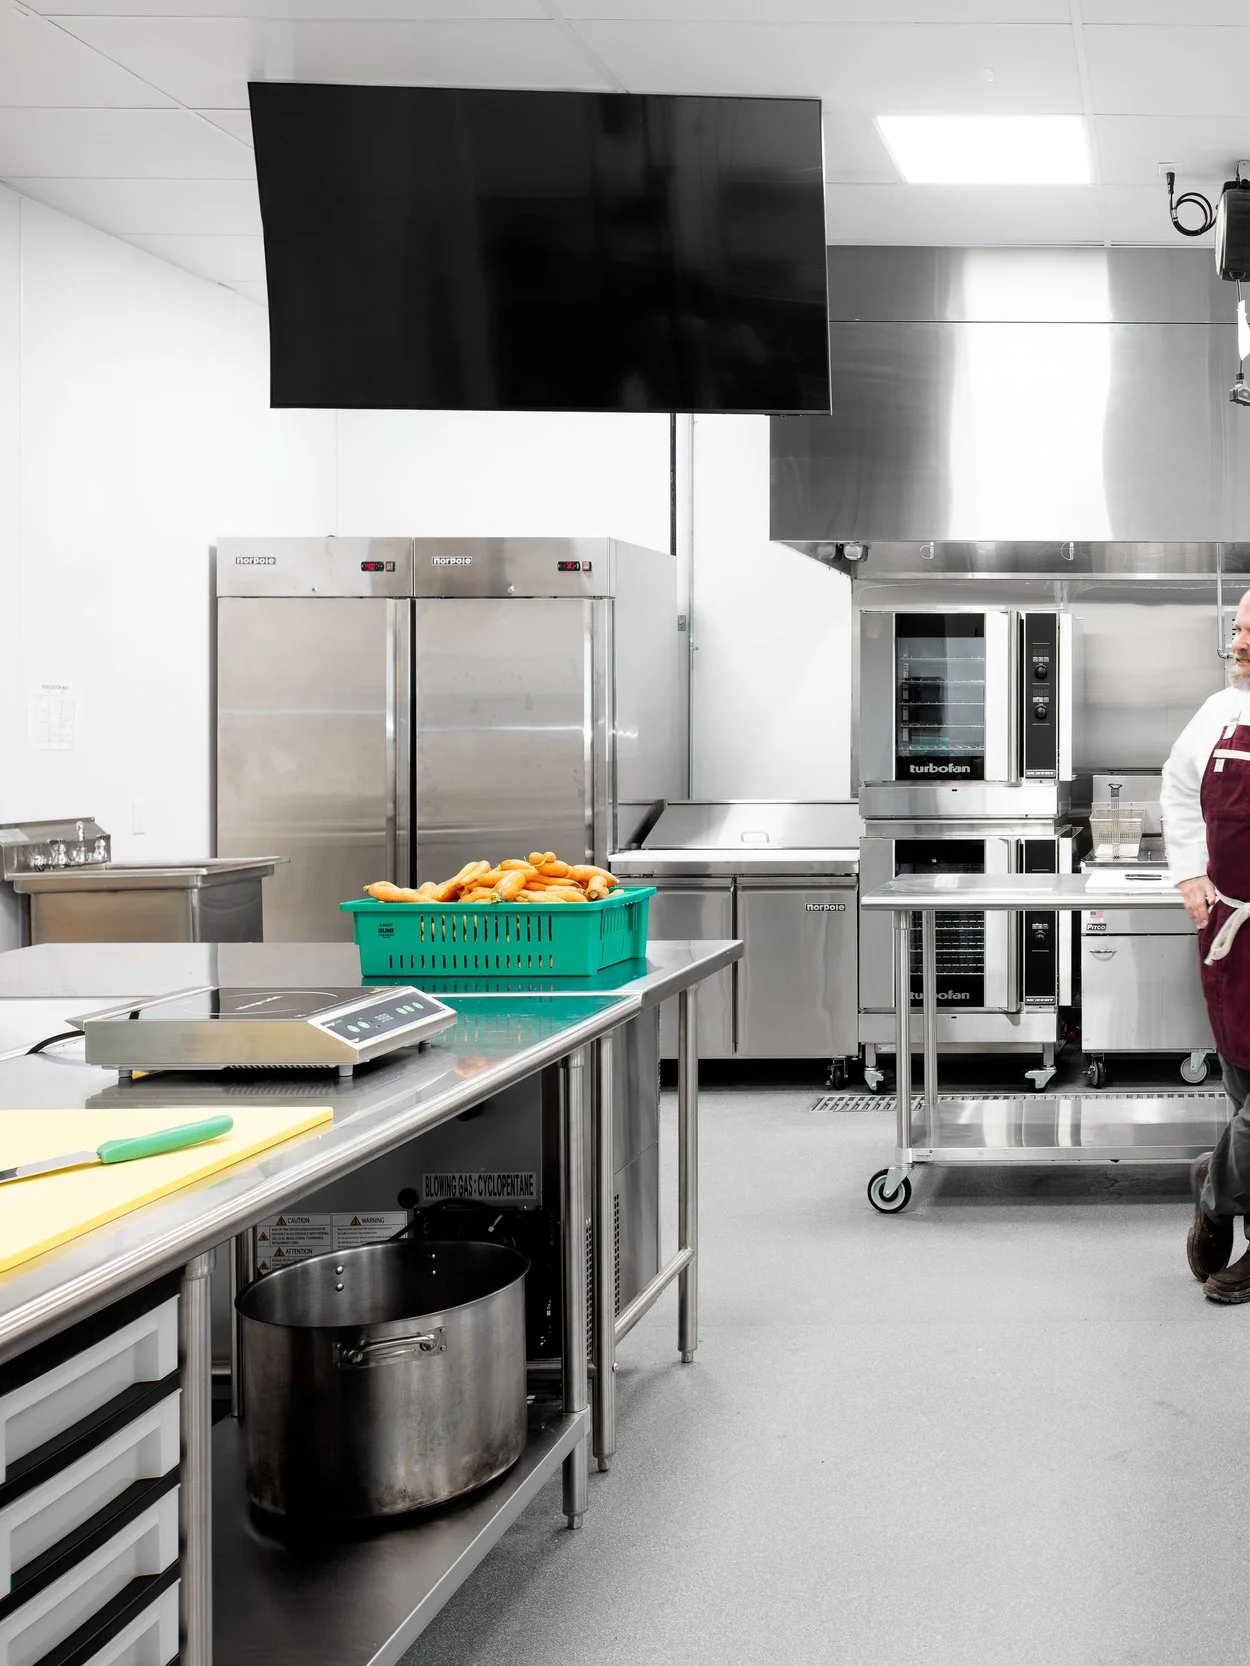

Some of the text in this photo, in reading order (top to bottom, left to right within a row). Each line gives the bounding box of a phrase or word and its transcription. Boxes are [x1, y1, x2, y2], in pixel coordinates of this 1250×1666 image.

[910, 763, 970, 773] turbofan
[910, 990, 970, 1000] tuofan
[425, 1175, 457, 1197] BLOWING
[478, 1174, 534, 1197] CYCLOPENTANE
[361, 1216, 385, 1224] WARNING
